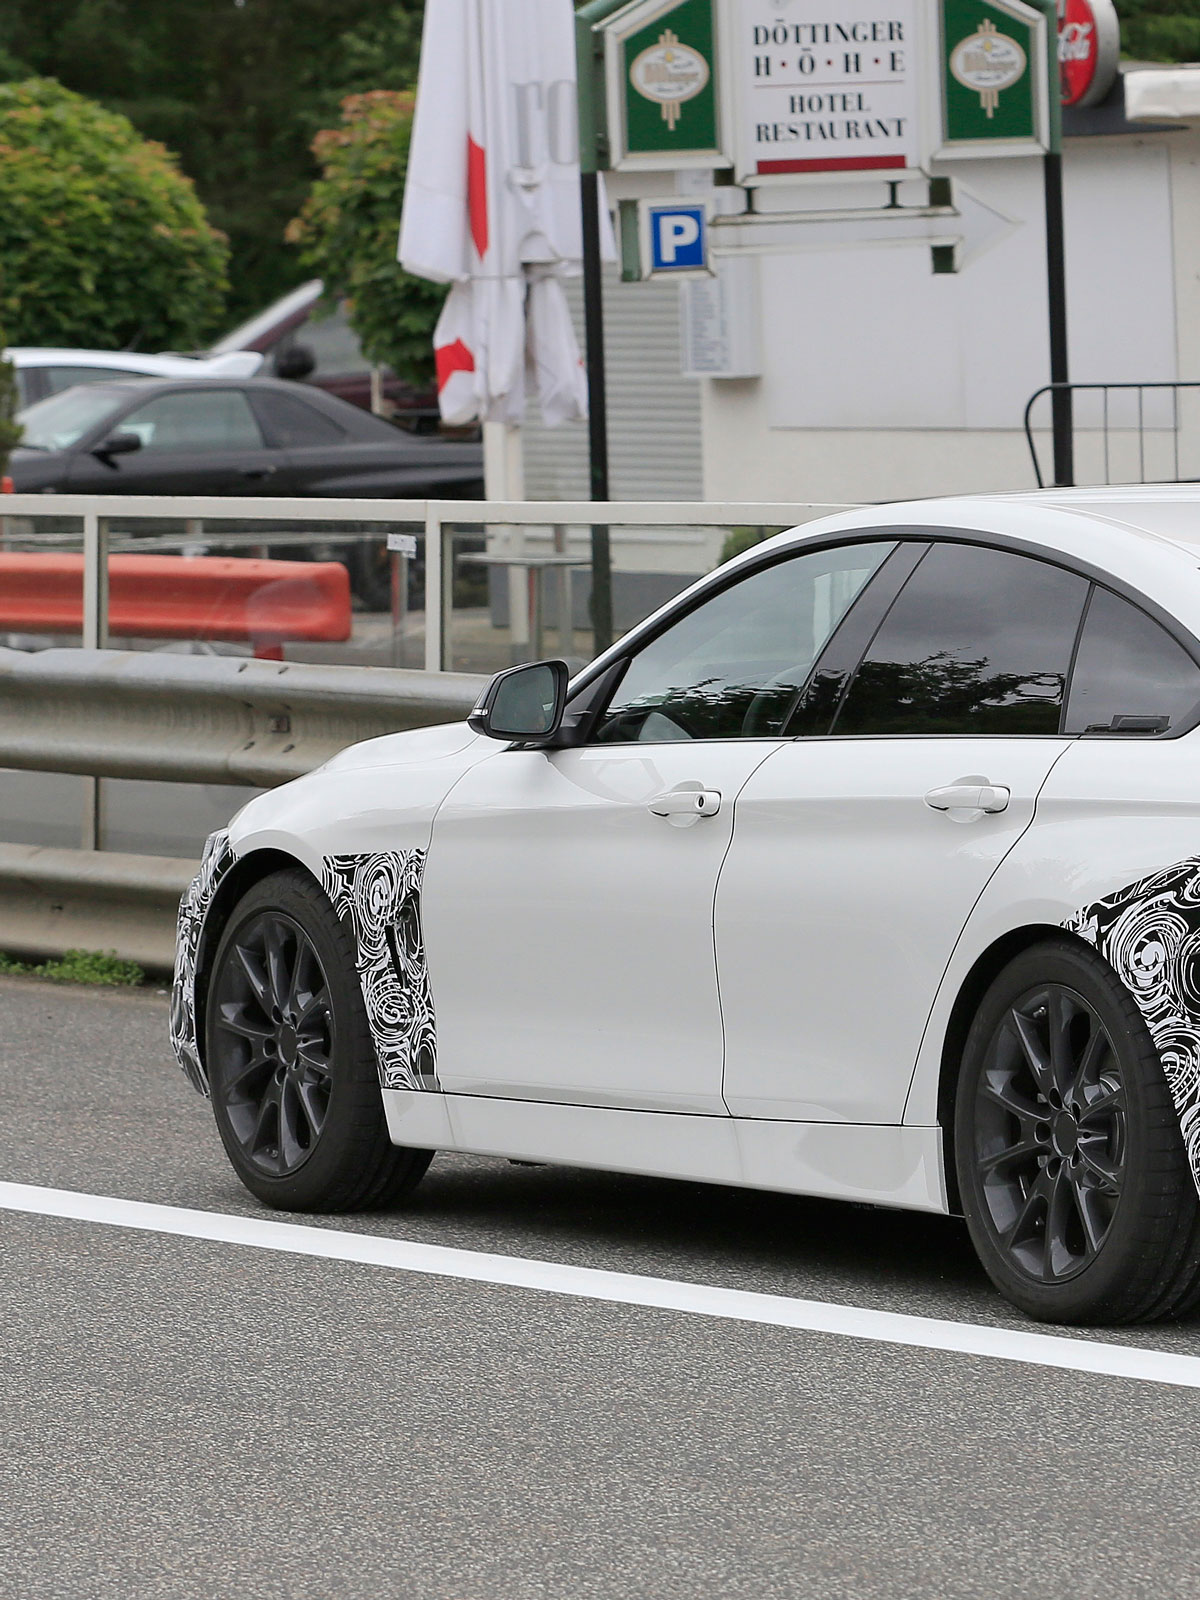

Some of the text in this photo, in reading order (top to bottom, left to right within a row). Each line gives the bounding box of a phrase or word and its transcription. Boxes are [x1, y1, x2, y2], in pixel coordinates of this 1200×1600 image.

[753, 18, 904, 46] DÖTTINGER
[790, 92, 872, 114] HOTEL
[756, 117, 907, 142] RESTAURANT
[659, 214, 700, 263] P
